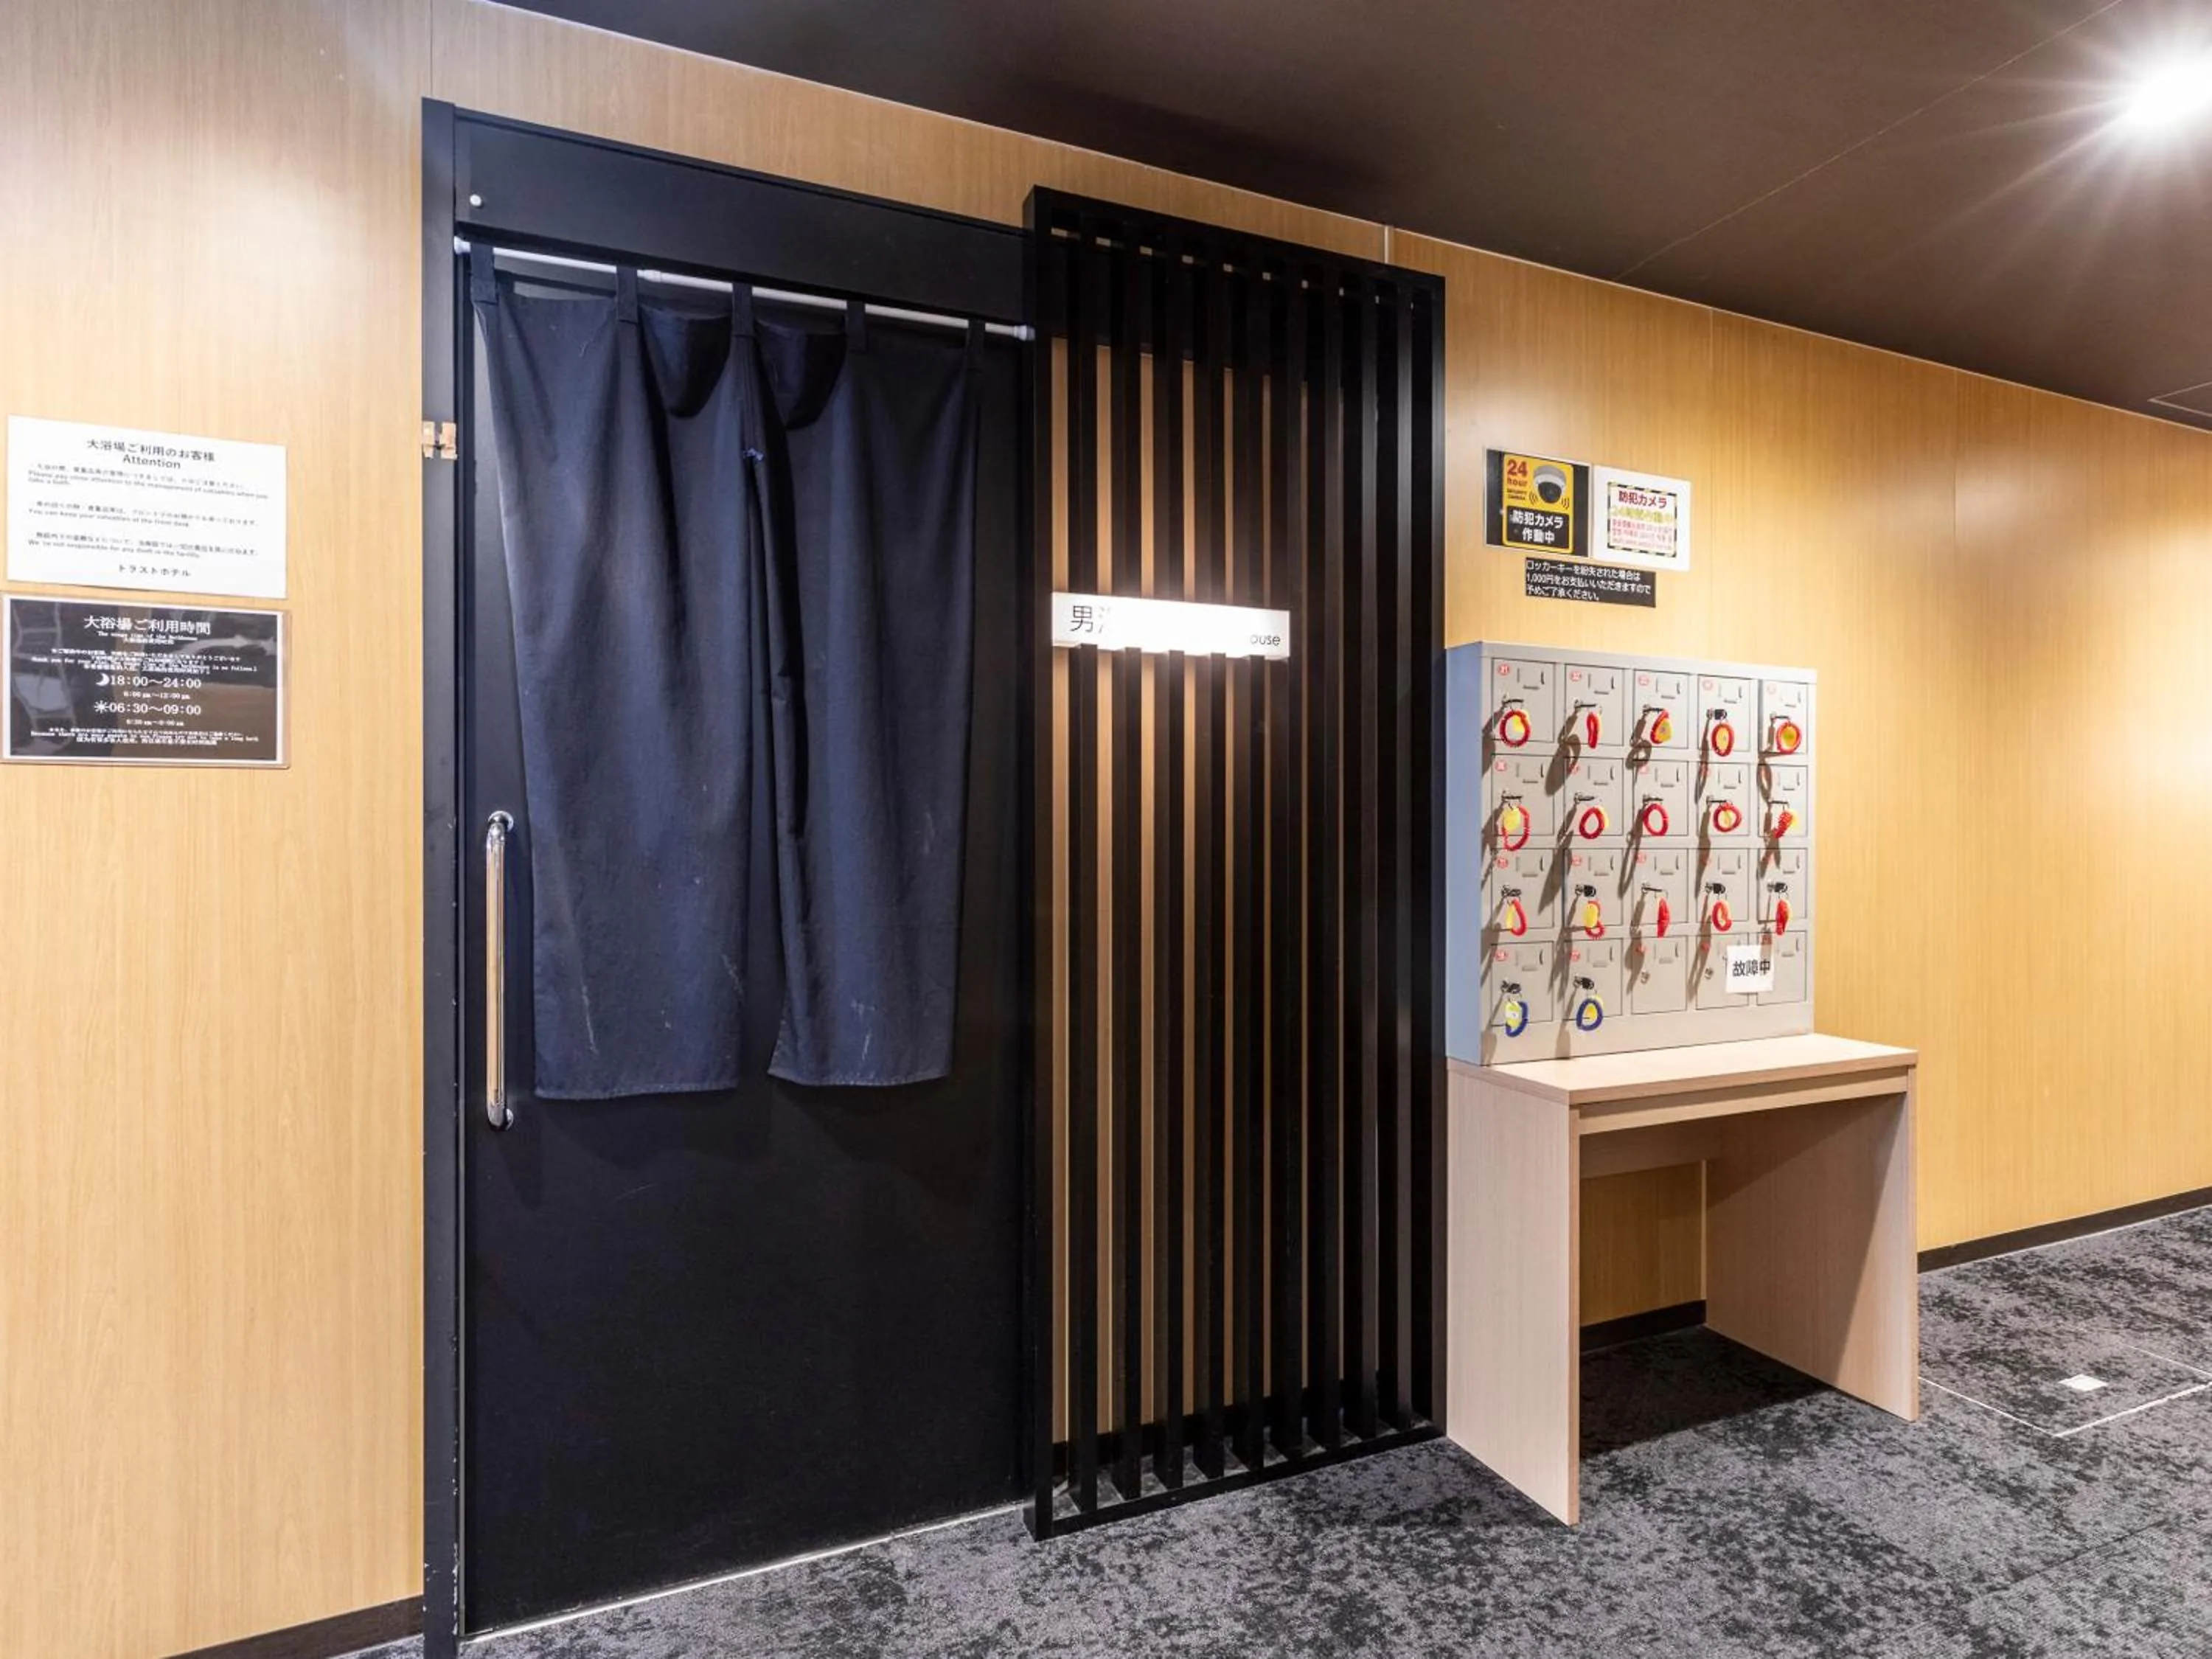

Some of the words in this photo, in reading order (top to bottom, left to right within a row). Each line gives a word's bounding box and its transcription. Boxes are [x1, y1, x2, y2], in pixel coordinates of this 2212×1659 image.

[87, 439, 215, 461] 大浴場ご利用のお客様
[122, 453, 181, 469] Attention
[1507, 459, 1528, 477] 24
[1507, 477, 1528, 487] hour
[1618, 490, 1668, 508] 防犯カメラ
[1512, 509, 1564, 529] 防犯カメラ
[1522, 526, 1555, 544] 作動中
[119, 564, 190, 577] トラストホテル
[1526, 560, 1641, 581] ロッカーキーを紛失された場合は
[1527, 586, 1599, 602] 予めご了承ください。
[83, 615, 210, 635] 大浴場ご利用時間
[1733, 959, 1770, 977] 故障中
